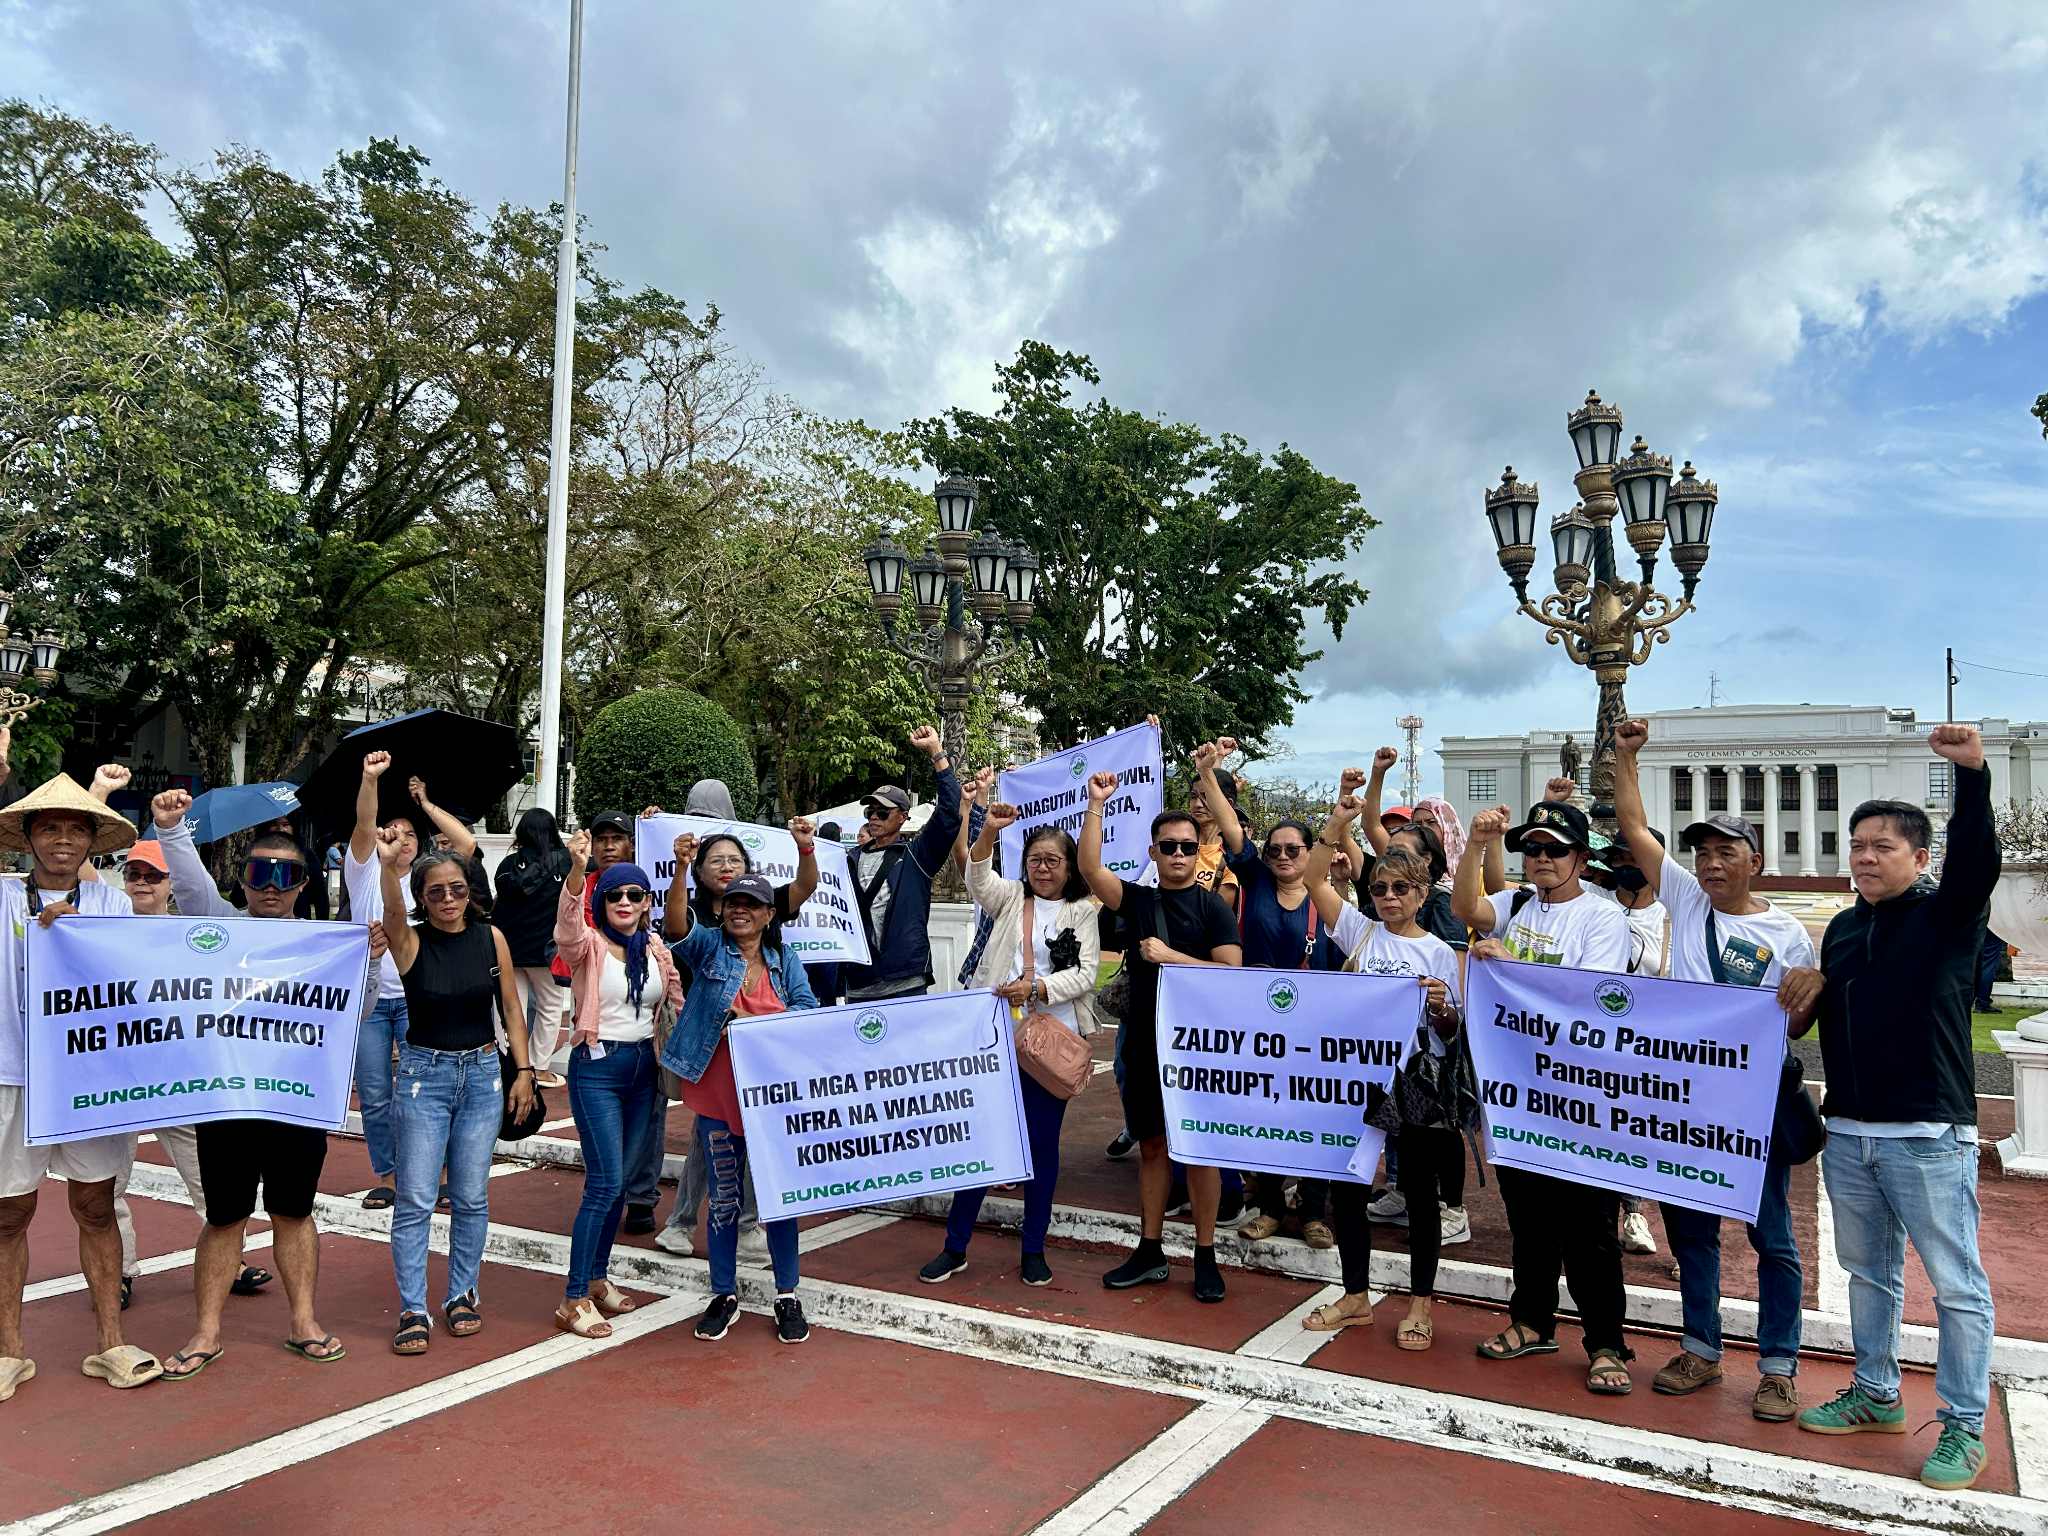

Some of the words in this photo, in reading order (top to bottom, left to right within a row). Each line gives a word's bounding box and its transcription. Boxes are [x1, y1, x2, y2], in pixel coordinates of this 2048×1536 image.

[1687, 750, 1745, 758] GOVERNMENT
[1769, 748, 1817, 757] SORSOGON
[1116, 765, 1155, 786] PWH,
[1015, 788, 1076, 821] ANAGUTIN
[1197, 870, 1214, 882] 05
[816, 912, 855, 935] BAY!
[43, 979, 138, 1017] IBALIK
[147, 977, 213, 1002] ANG
[223, 977, 351, 1012] NINAKAW
[66, 1025, 107, 1055] NG
[116, 1015, 185, 1048] MGA
[195, 1012, 325, 1048] POLITIKO!
[1171, 1026, 1246, 1055] ZALDY
[1253, 1031, 1287, 1059] CO
[1320, 1036, 1403, 1067] DPWH
[1494, 1002, 1561, 1047] Zaldy
[1568, 1019, 1606, 1049] Co
[1614, 1026, 1750, 1070] Pauwiin!
[72, 1076, 246, 1110] BUNGKARAS
[253, 1077, 316, 1098] BICOL
[742, 1080, 803, 1108] ITIGIL
[808, 1073, 859, 1099] MGA
[863, 1052, 1001, 1091] PROYEKTONG
[1162, 1063, 1281, 1104] CORRUPT,
[1534, 1052, 1692, 1105] Panagutin!
[785, 1108, 842, 1136] NFRA
[848, 1101, 879, 1126] NA
[884, 1088, 975, 1120] WALANG
[1180, 1118, 1314, 1144] BUNGKARAS
[1526, 1087, 1602, 1129] BIKOL
[1610, 1106, 1770, 1163] Patalsikin!
[796, 1120, 971, 1167] KONSULTASYON!
[1491, 1124, 1649, 1170] BUNGKARAS
[1655, 1159, 1735, 1189] BICOL
[781, 1171, 924, 1205] BUNGKARAS
[930, 1159, 995, 1181] BICOL
